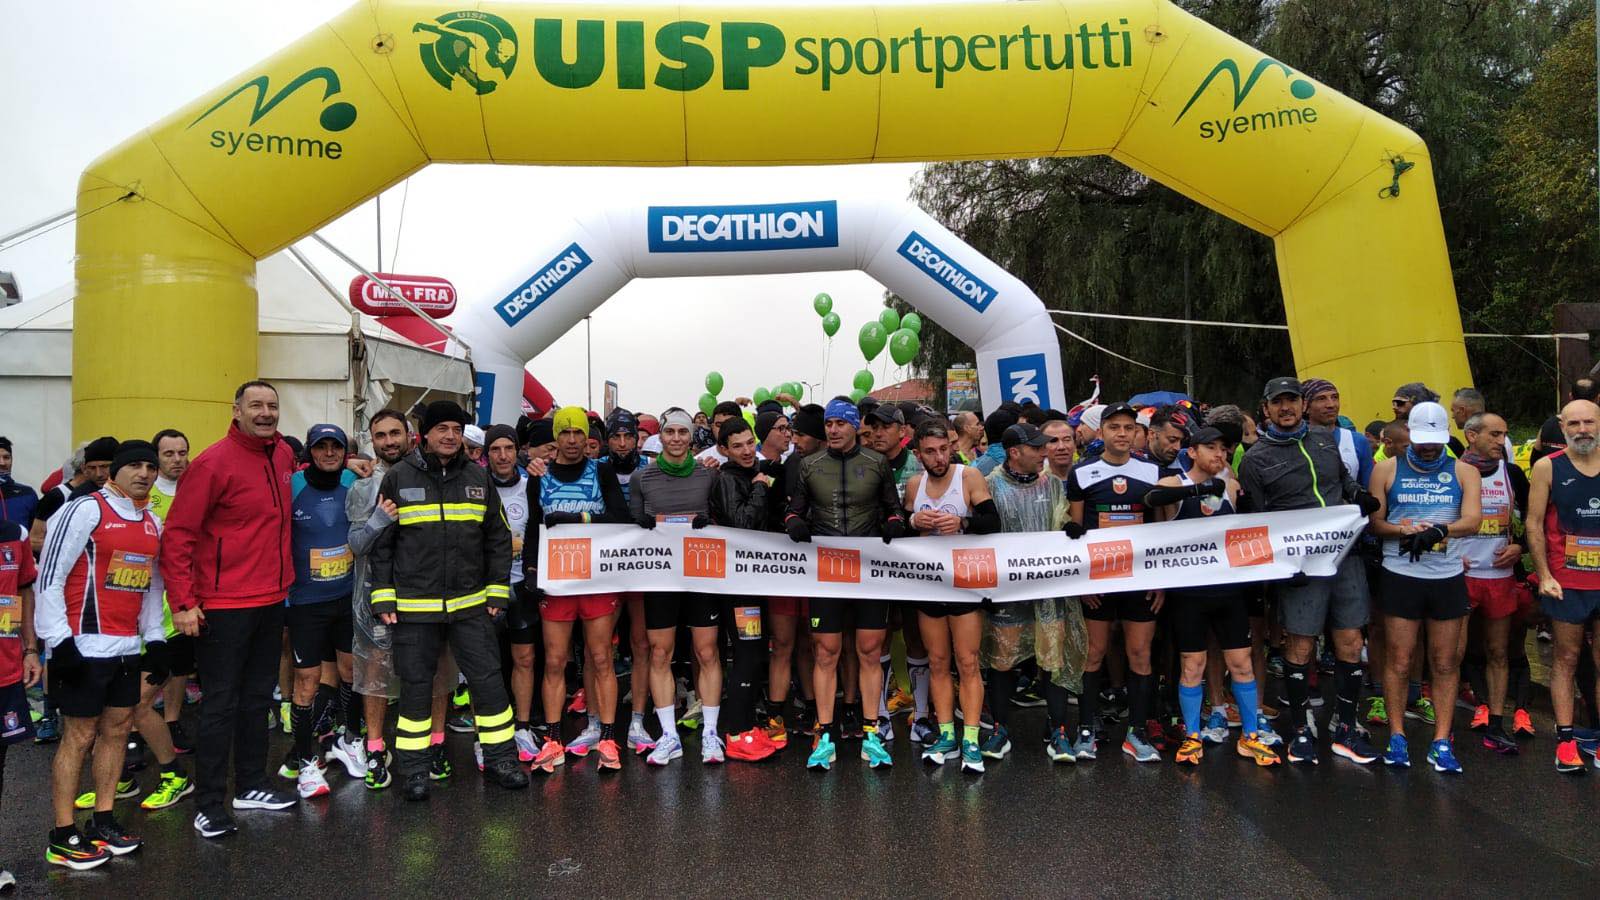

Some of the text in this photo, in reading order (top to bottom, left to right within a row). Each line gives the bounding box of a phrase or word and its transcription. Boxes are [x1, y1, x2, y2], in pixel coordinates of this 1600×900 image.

[534, 18, 1132, 91] UISP sportpertutti
[1200, 107, 1318, 142] syemme
[210, 130, 342, 160] syemme
[662, 210, 823, 241] DECATHLON
[907, 240, 988, 304] DECATHLON
[503, 251, 582, 318] DECATHLON
[1402, 482, 1441, 490] saucony
[1479, 519, 1500, 534] 43
[1283, 530, 1354, 543] MARATONA
[600, 547, 673, 558] MARATONA
[735, 550, 807, 562] MARATONA
[1145, 542, 1218, 557] MARATONA
[1286, 543, 1345, 556] DI RAGUS
[600, 560, 672, 572] DI RAGUSA
[871, 559, 945, 571] MARATONA
[1008, 554, 1081, 568] MARATONA
[1144, 555, 1218, 569] DI RAGUSA
[1576, 551, 1600, 568] 65
[320, 558, 348, 577] 829
[735, 563, 806, 575] DI RAGUSA
[1009, 568, 1080, 581] DI RAGUSA
[113, 567, 149, 588] 1039
[871, 569, 943, 582] DI RAGUSA
